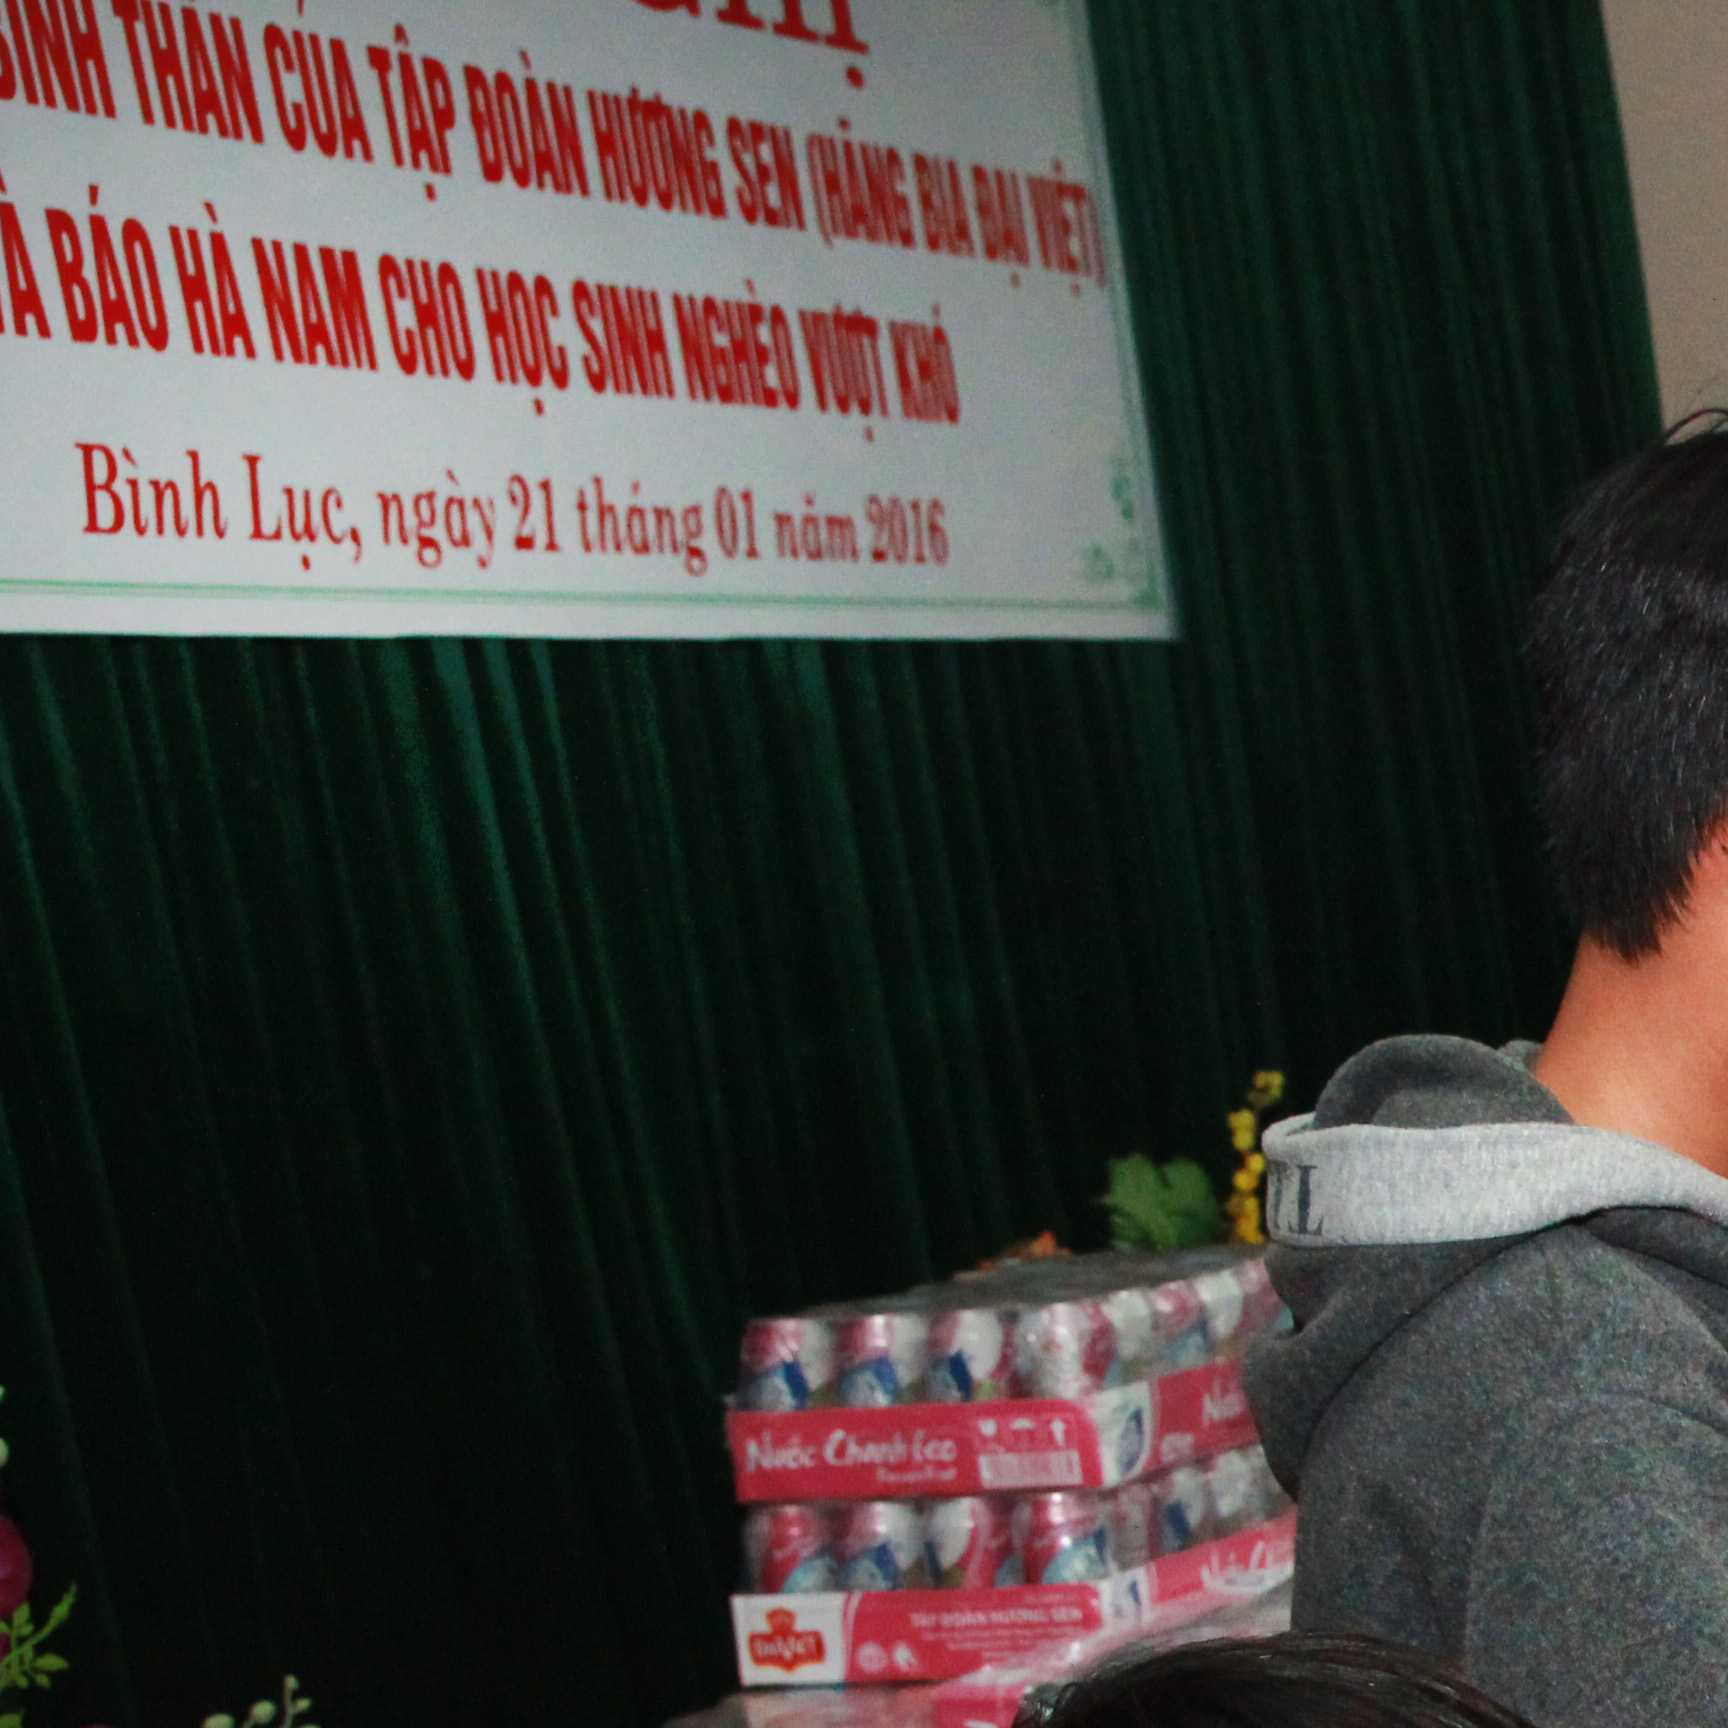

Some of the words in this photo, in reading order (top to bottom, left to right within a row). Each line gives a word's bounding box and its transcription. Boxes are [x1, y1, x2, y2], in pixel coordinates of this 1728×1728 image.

[367, 23, 457, 201] TẬP
[463, 49, 591, 198] ĐOÀN
[726, 116, 807, 231] SEN
[912, 152, 977, 259] BIA
[45, 184, 169, 352] BÁO
[169, 202, 256, 359] HÀ
[251, 236, 379, 371] NAM
[379, 254, 475, 383] CHO
[475, 267, 570, 415] HỌC
[573, 278, 676, 399] SINH
[672, 278, 800, 411] NGHÈO
[799, 303, 890, 444] VƯỢT
[76, 442, 227, 539] Bình
[242, 454, 364, 571] Lục,
[377, 468, 496, 570] ngày
[508, 474, 562, 554] 21
[576, 474, 708, 577] tháng
[715, 486, 761, 560] 01
[774, 494, 860, 563] năm
[866, 494, 950, 566] 2016
